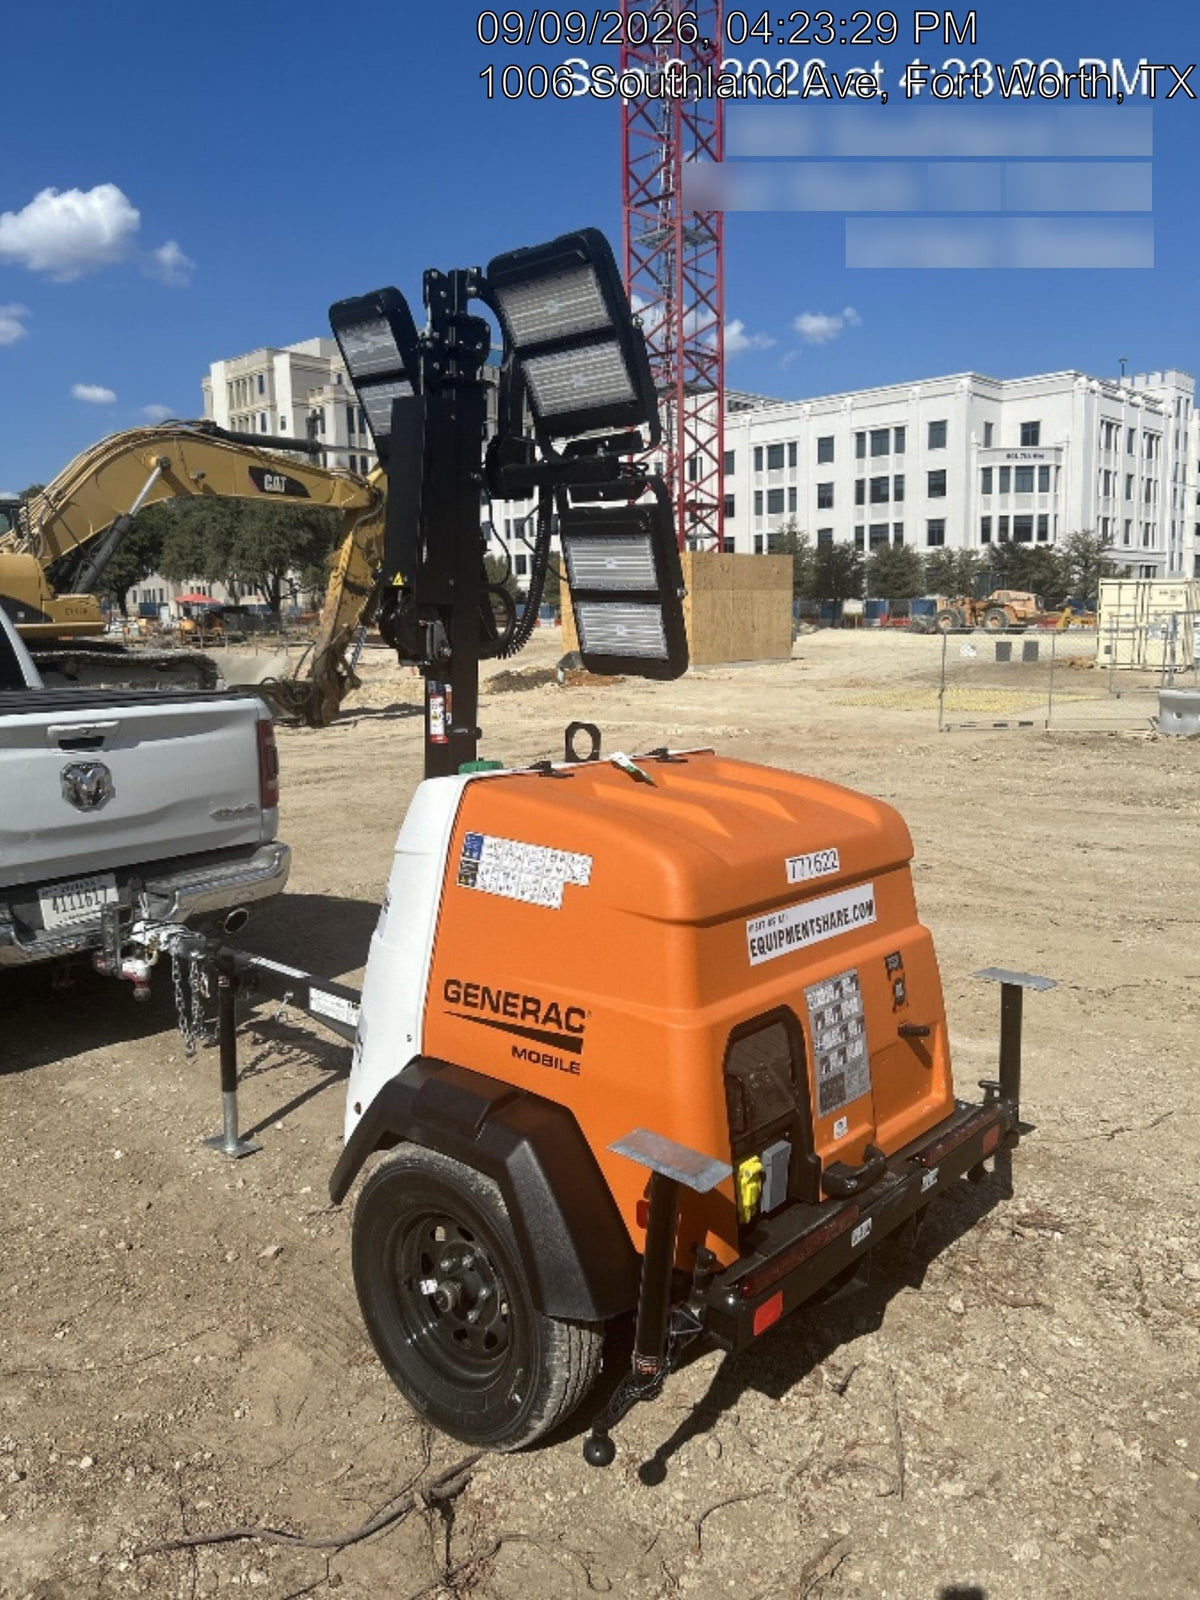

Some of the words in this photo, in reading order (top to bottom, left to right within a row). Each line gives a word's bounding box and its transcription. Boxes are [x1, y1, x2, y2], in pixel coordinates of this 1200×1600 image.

[264, 474, 287, 493] CAT
[749, 899, 874, 958] EQUIPMENTSHARE.COM
[444, 979, 586, 1034] GENERAC
[511, 1045, 581, 1075] MOBILE
